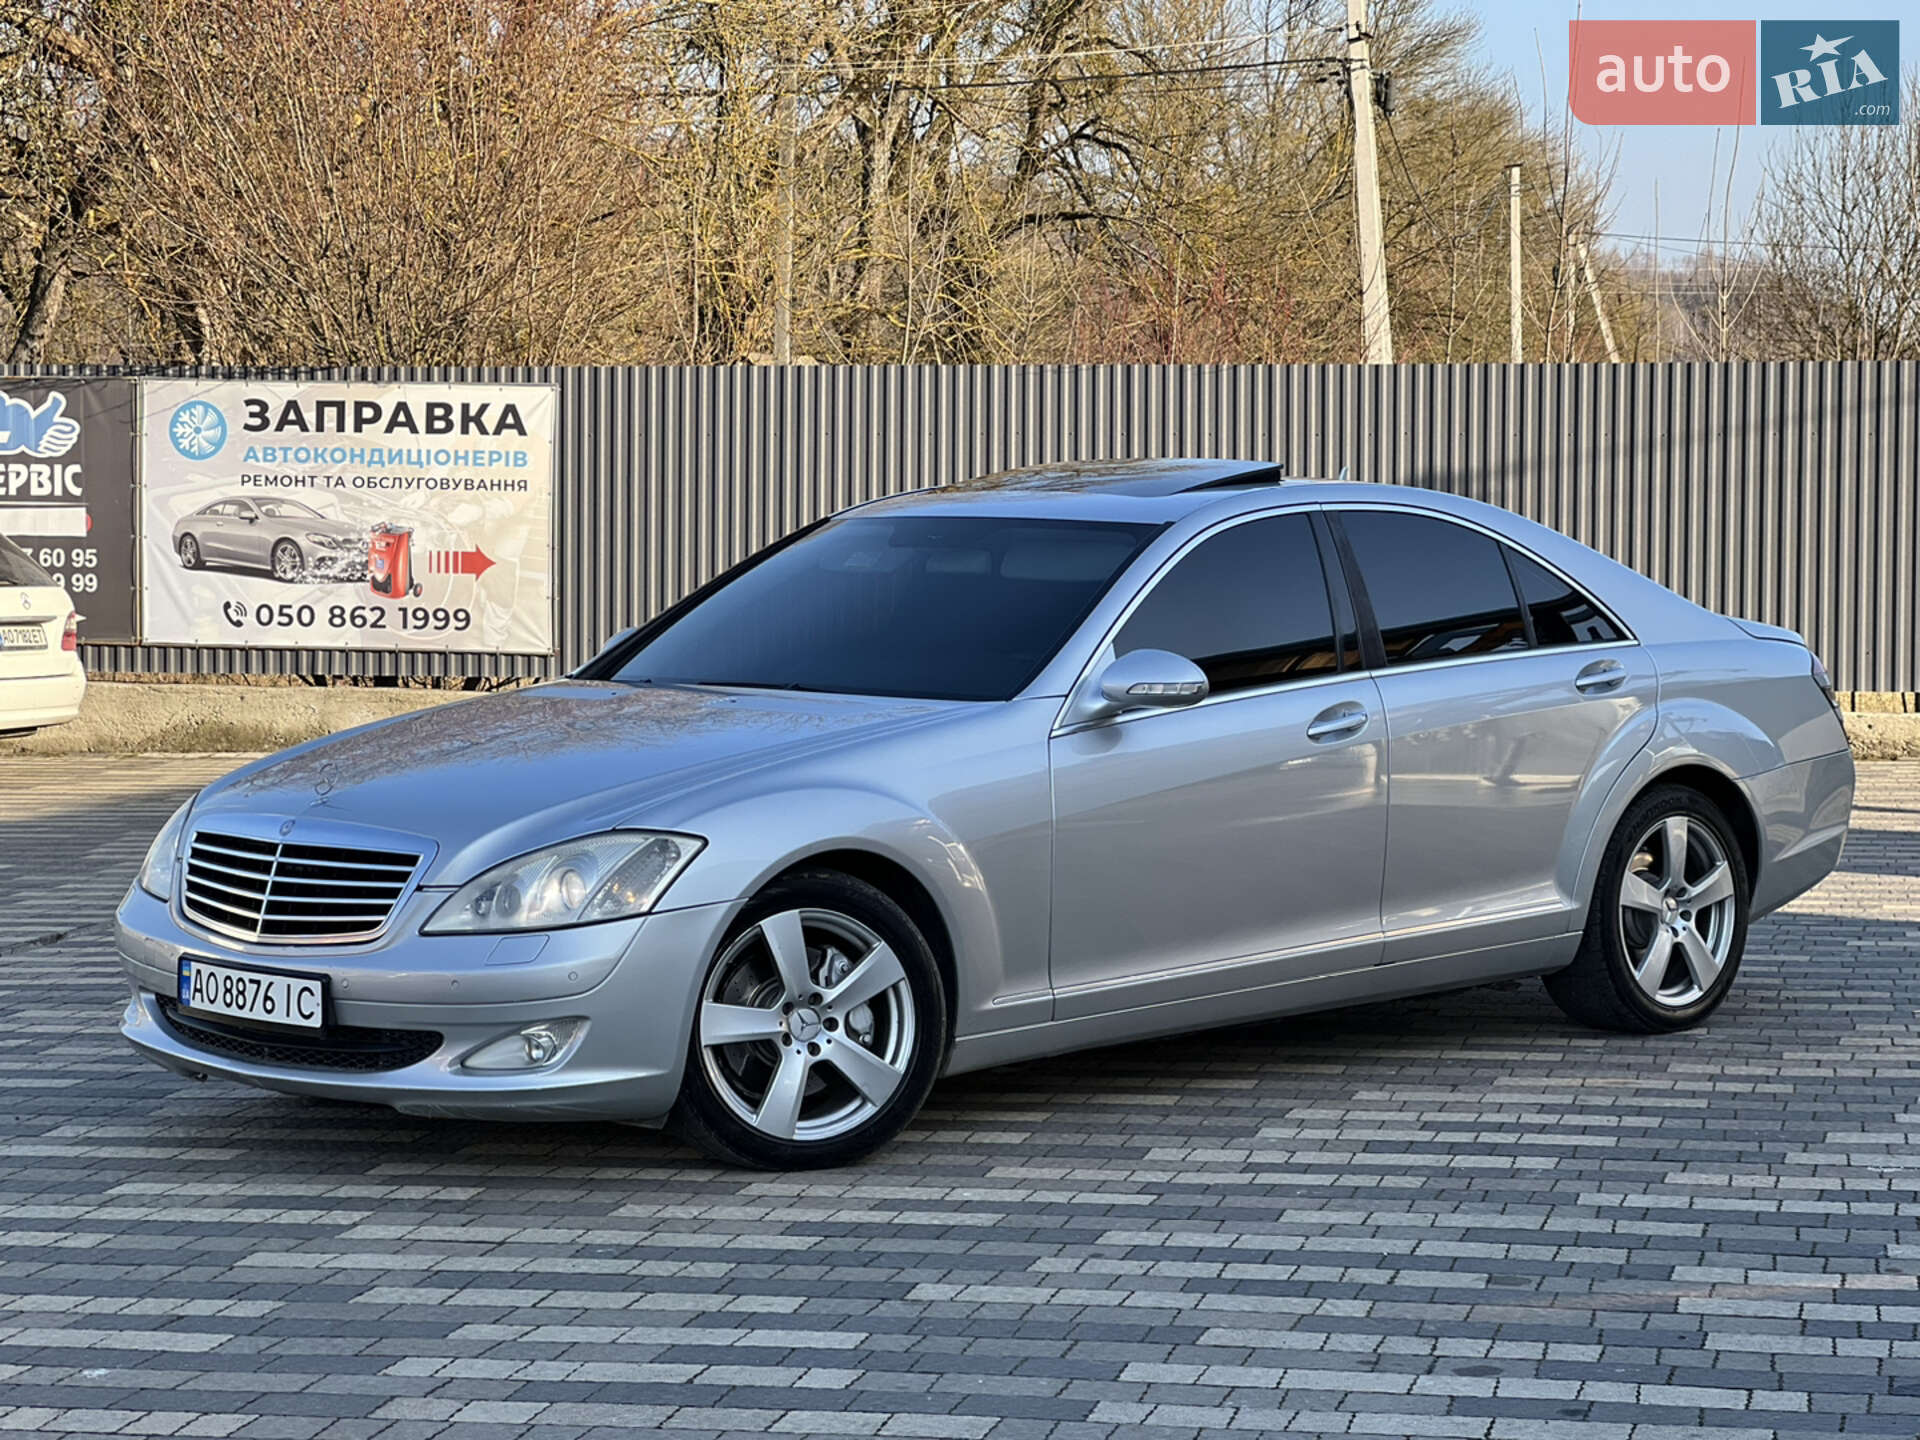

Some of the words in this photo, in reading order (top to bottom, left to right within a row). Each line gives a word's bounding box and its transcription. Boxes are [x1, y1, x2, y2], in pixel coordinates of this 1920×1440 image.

[242, 398, 528, 437] ЗАПРАВКА
[242, 446, 528, 468] АВТОКОНДИЦІОНЕРІВ
[240, 474, 317, 489] РЕМОНТ
[323, 475, 346, 489] ТА
[352, 475, 528, 492] ОБСЛУГОВУВАННЯ
[39, 548, 65, 567] 60
[71, 548, 98, 568] 95
[71, 573, 98, 592] 99
[255, 603, 316, 627] 050
[327, 605, 387, 629] 862
[398, 606, 471, 631] 1999
